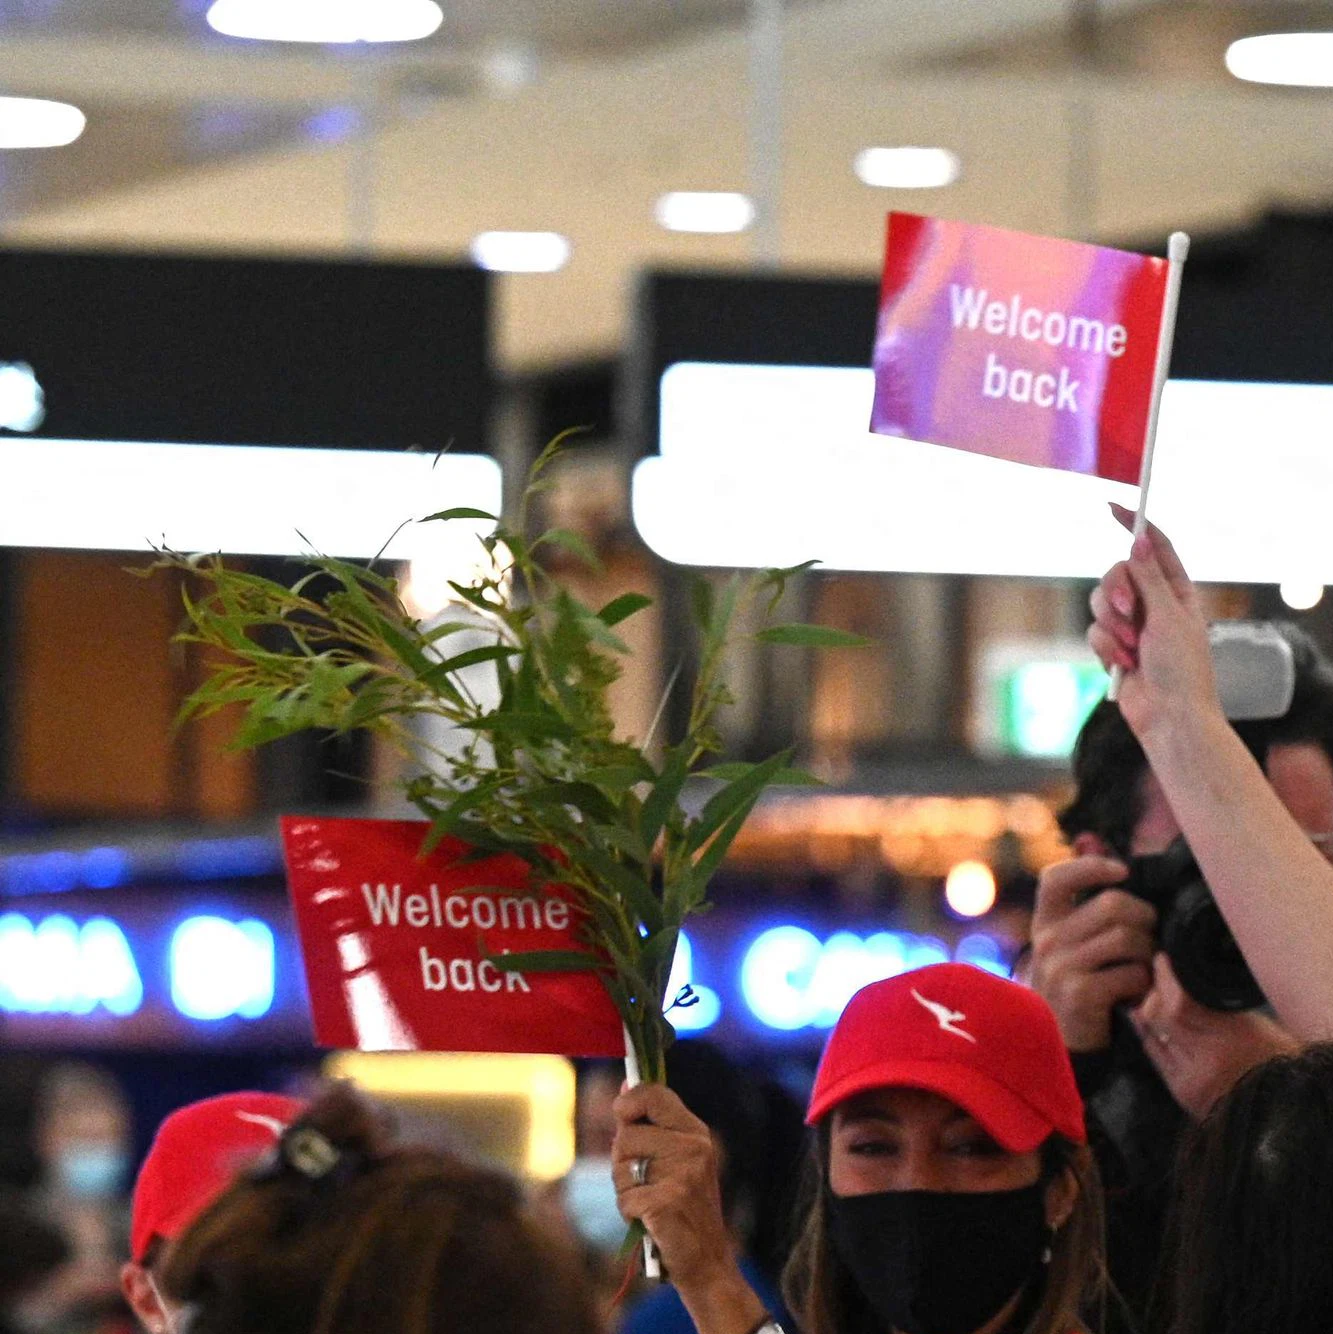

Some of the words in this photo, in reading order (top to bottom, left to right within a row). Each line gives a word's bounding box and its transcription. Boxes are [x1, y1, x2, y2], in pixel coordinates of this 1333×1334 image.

[949, 284, 1128, 358] Welcome
[982, 353, 1081, 414] back
[361, 883, 570, 931] Welcome
